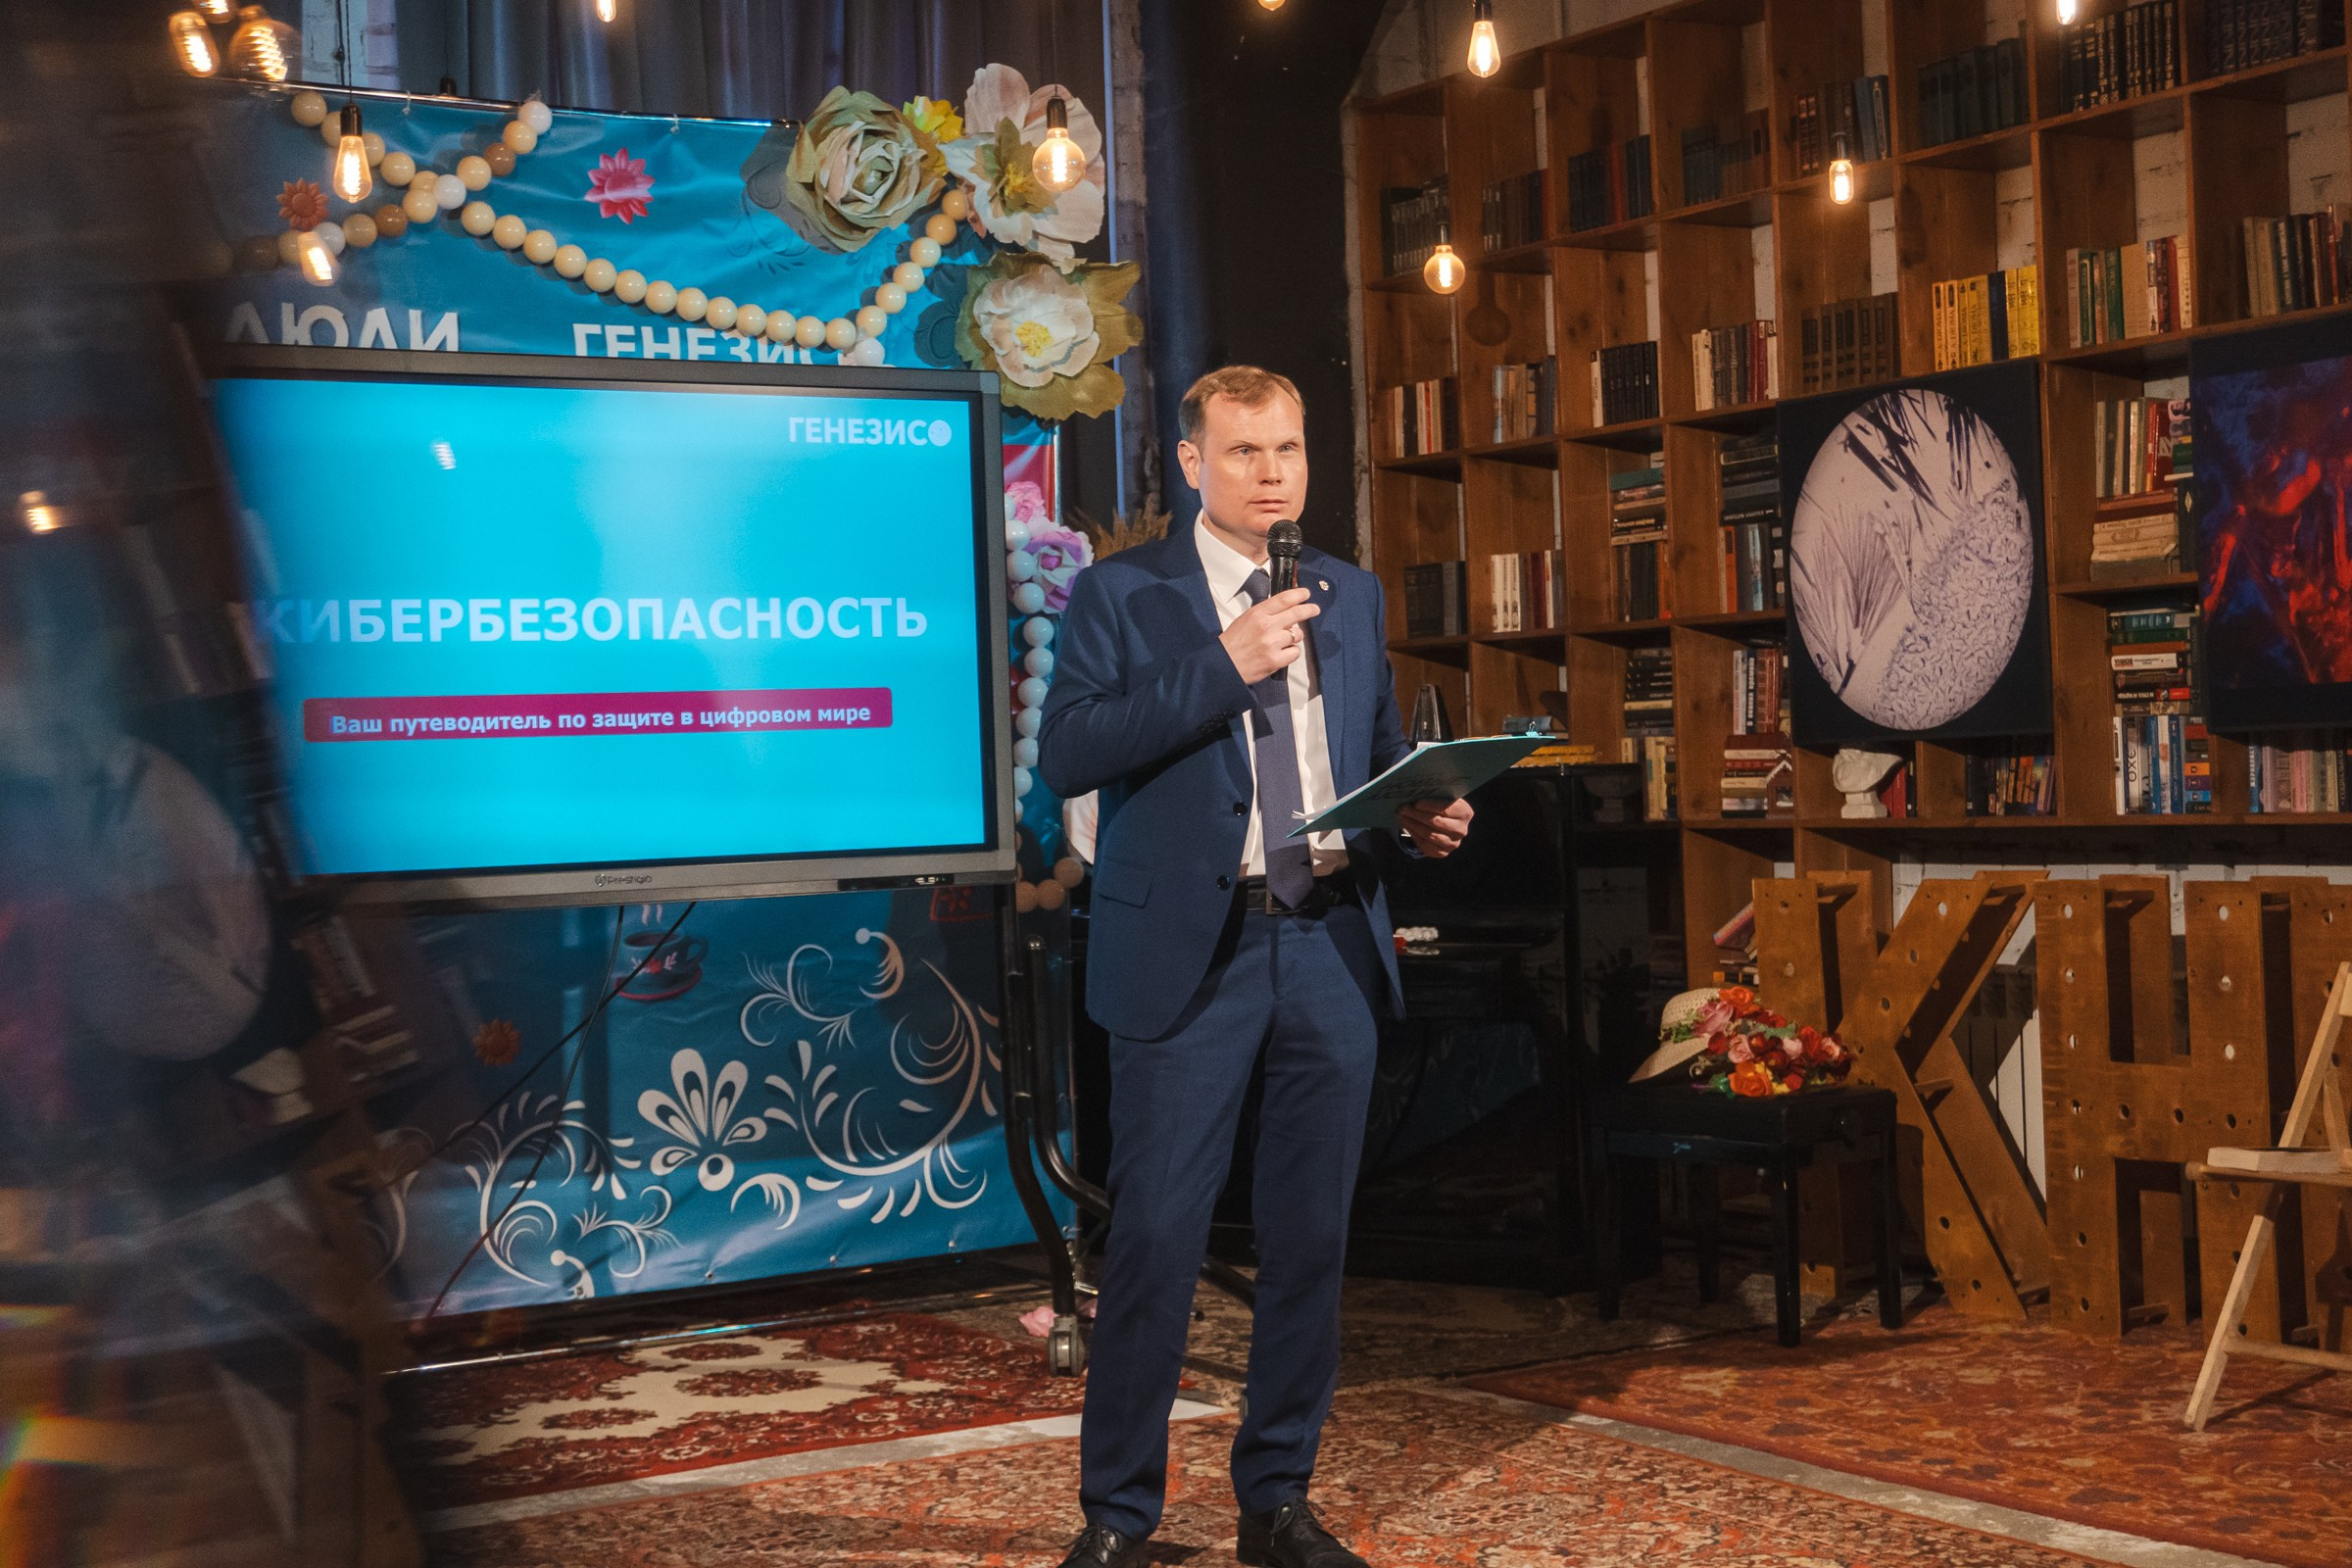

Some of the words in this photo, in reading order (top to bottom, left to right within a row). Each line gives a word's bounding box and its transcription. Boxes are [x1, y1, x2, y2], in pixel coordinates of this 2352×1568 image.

[789, 416, 929, 446] ГЕНЕЗИС
[255, 597, 928, 644] КИБЕРБЕЗОПАСНОСТЬ
[331, 715, 382, 733] Ваш
[390, 713, 551, 736] путеводитель
[559, 713, 585, 728] по
[593, 710, 674, 729] защите
[681, 711, 693, 725] в
[701, 707, 810, 728] цифровом
[818, 708, 870, 725] мире
